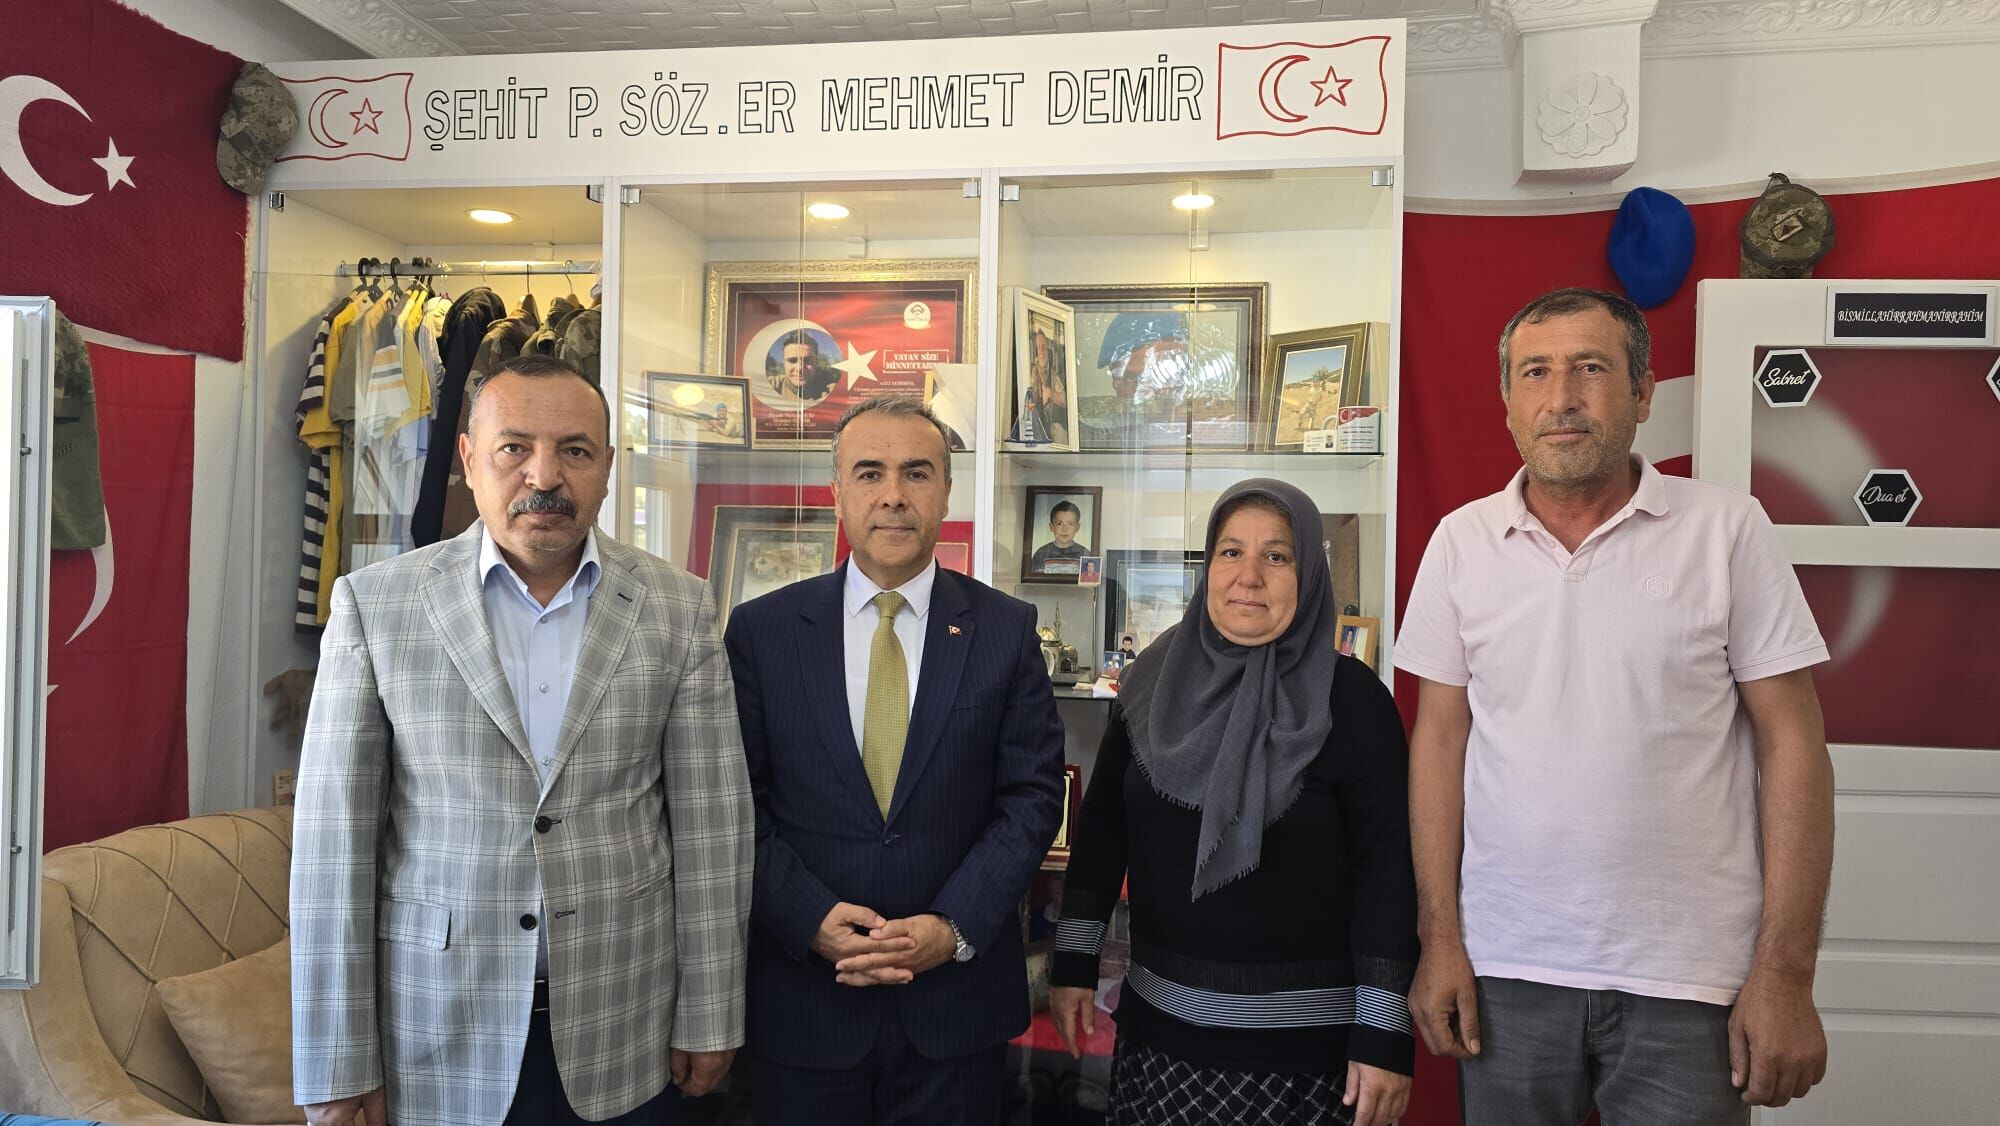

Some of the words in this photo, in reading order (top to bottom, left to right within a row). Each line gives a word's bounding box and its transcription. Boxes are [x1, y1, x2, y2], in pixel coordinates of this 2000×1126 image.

[424, 77, 547, 150] ŞEHİT
[569, 86, 602, 137] P.
[821, 72, 1024, 132] MEHMET
[1048, 54, 1203, 125] DEMİR
